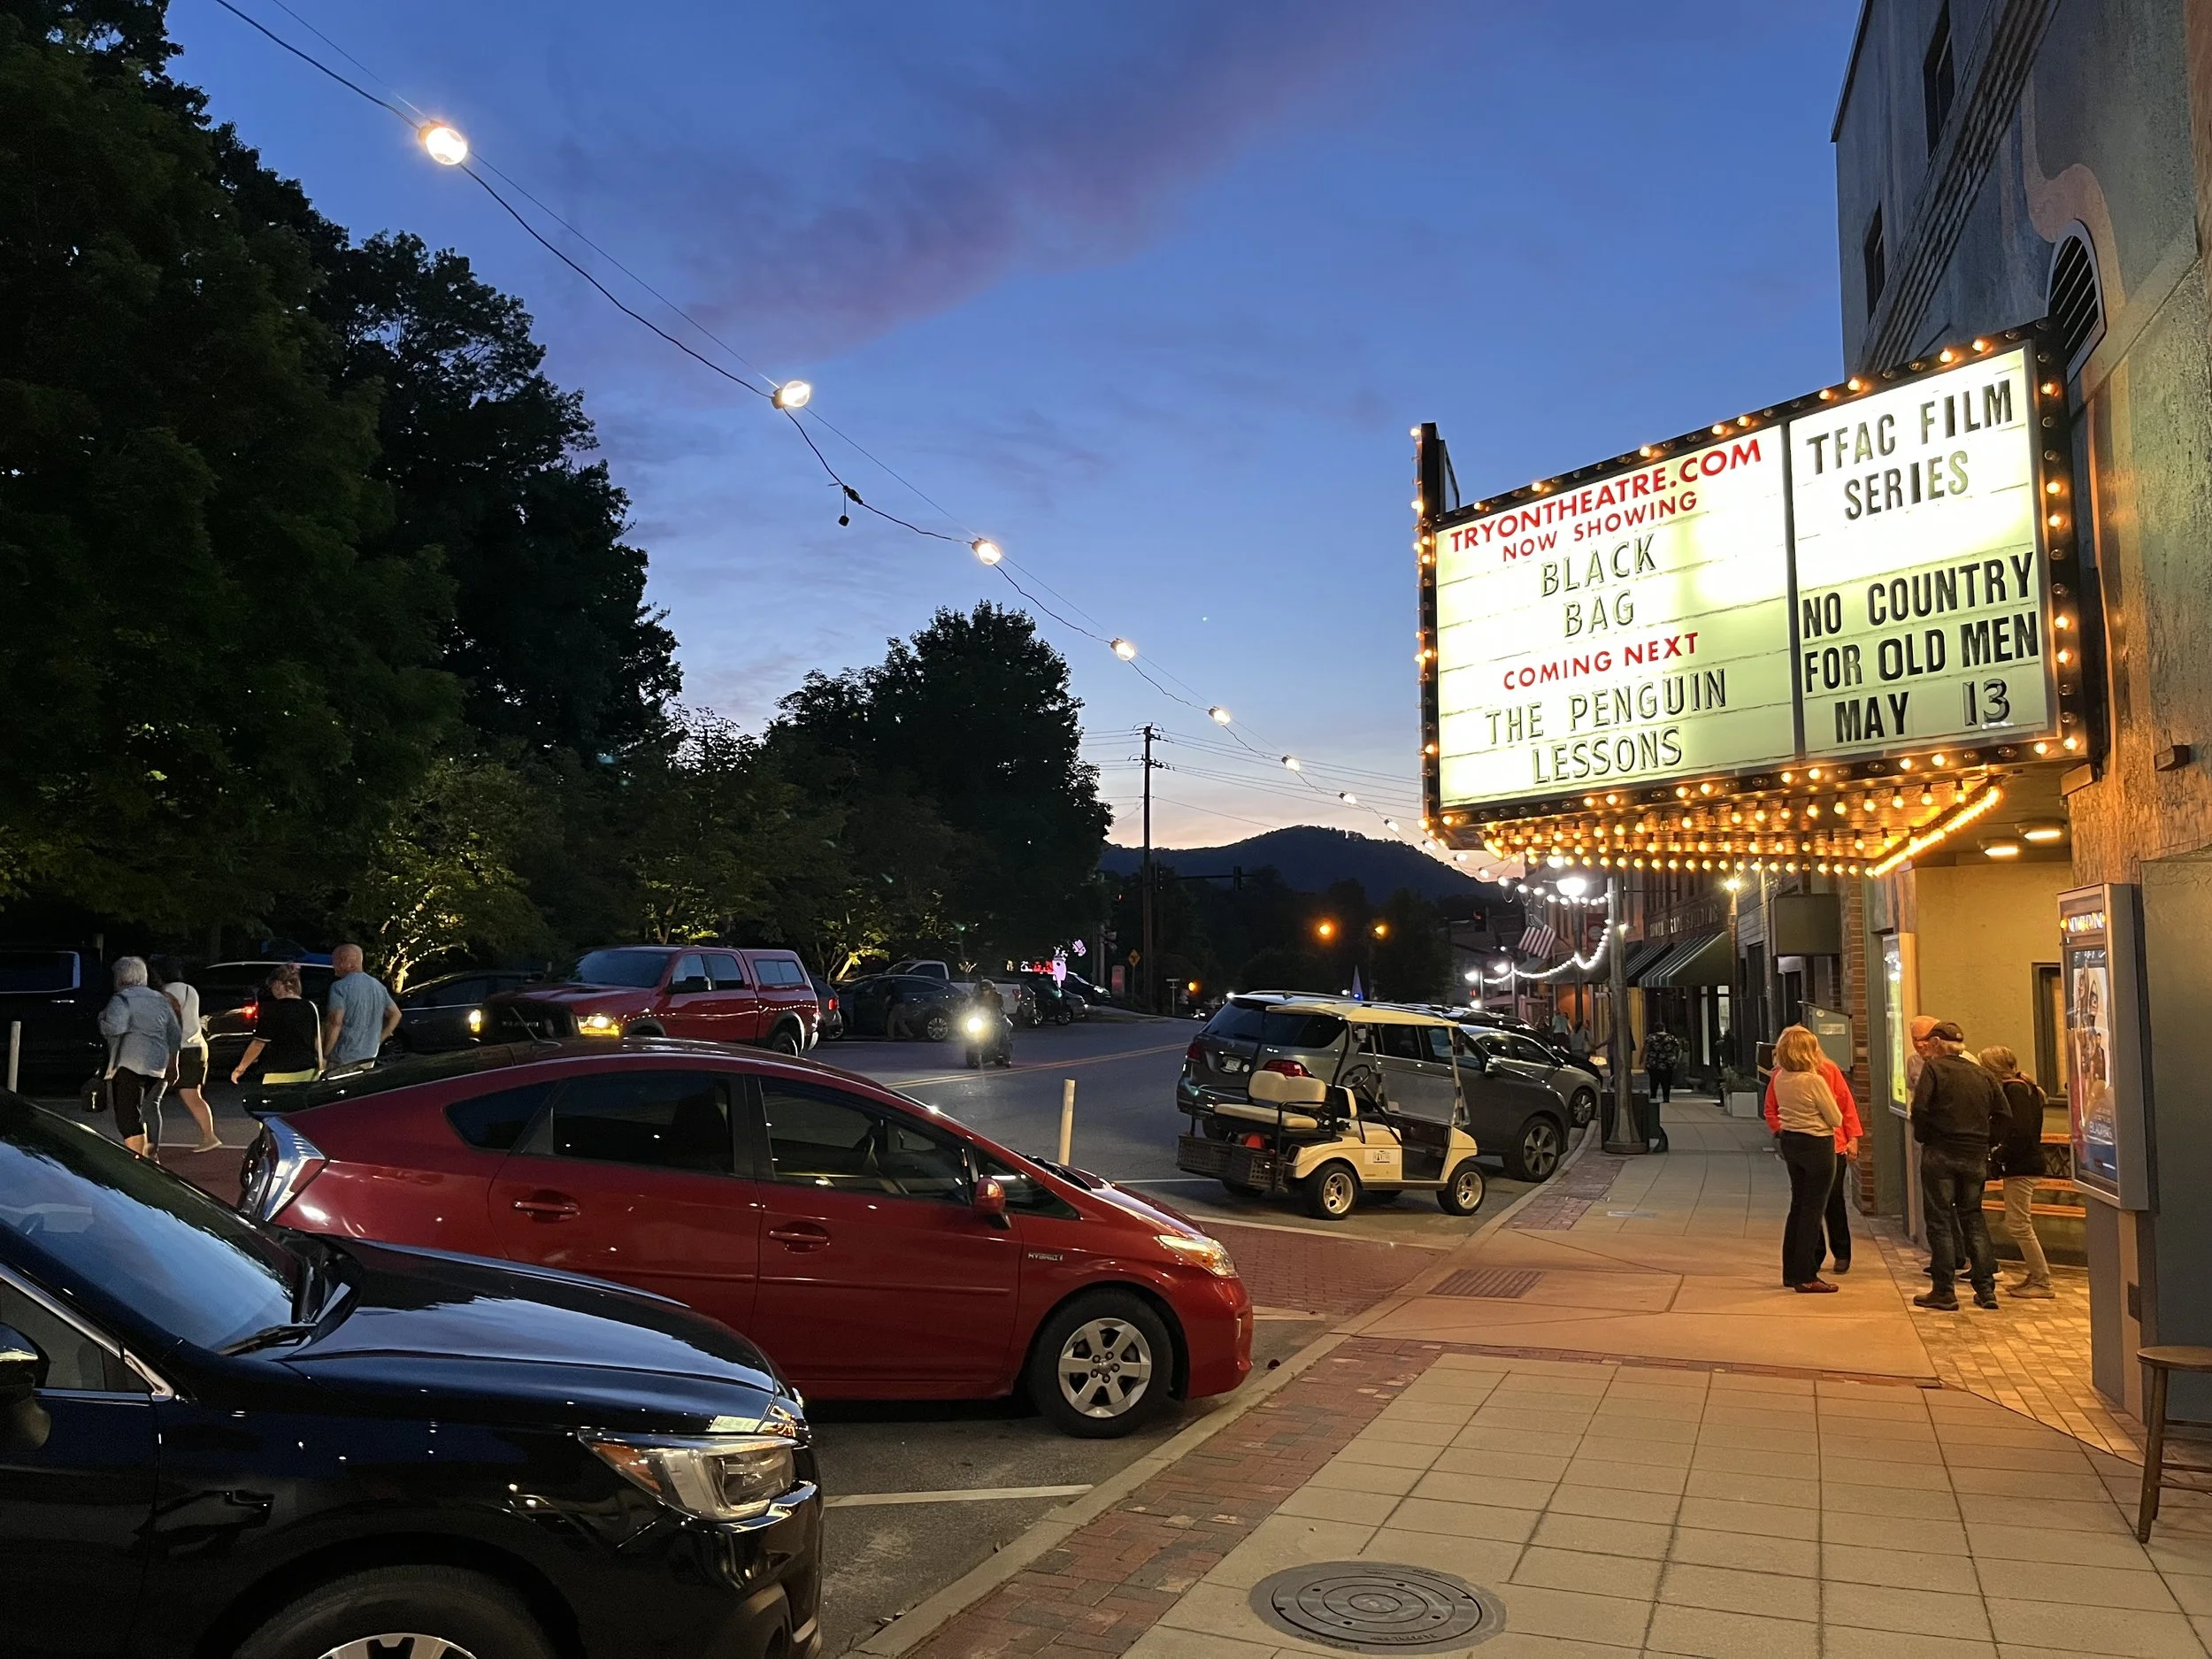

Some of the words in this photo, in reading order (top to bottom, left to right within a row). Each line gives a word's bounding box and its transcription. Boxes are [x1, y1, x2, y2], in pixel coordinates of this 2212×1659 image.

[1806, 413, 1895, 475] TFAC
[1919, 379, 2013, 445] FILM
[1450, 439, 1762, 552] TRYONTHEATRE.COM
[1844, 450, 1969, 521] SERIES
[1502, 531, 1557, 562] NOW
[1574, 491, 1698, 542] SHOWING
[1540, 534, 1656, 597] BLACK
[1802, 592, 1842, 639] NO
[1867, 551, 2033, 626] COUNTRY
[1563, 589, 1634, 638] BAG
[1503, 650, 1612, 690] COMING
[1624, 632, 1699, 666] NEXT
[1804, 643, 1863, 693] FOR
[1878, 629, 1946, 681] OLD
[1960, 611, 2039, 668] MEN
[1485, 702, 1544, 745] THE
[1569, 668, 1726, 732] PENGUIN
[1834, 691, 1909, 743] MAY
[1962, 678, 2010, 726] 13
[1532, 726, 1683, 784] LESSONS
